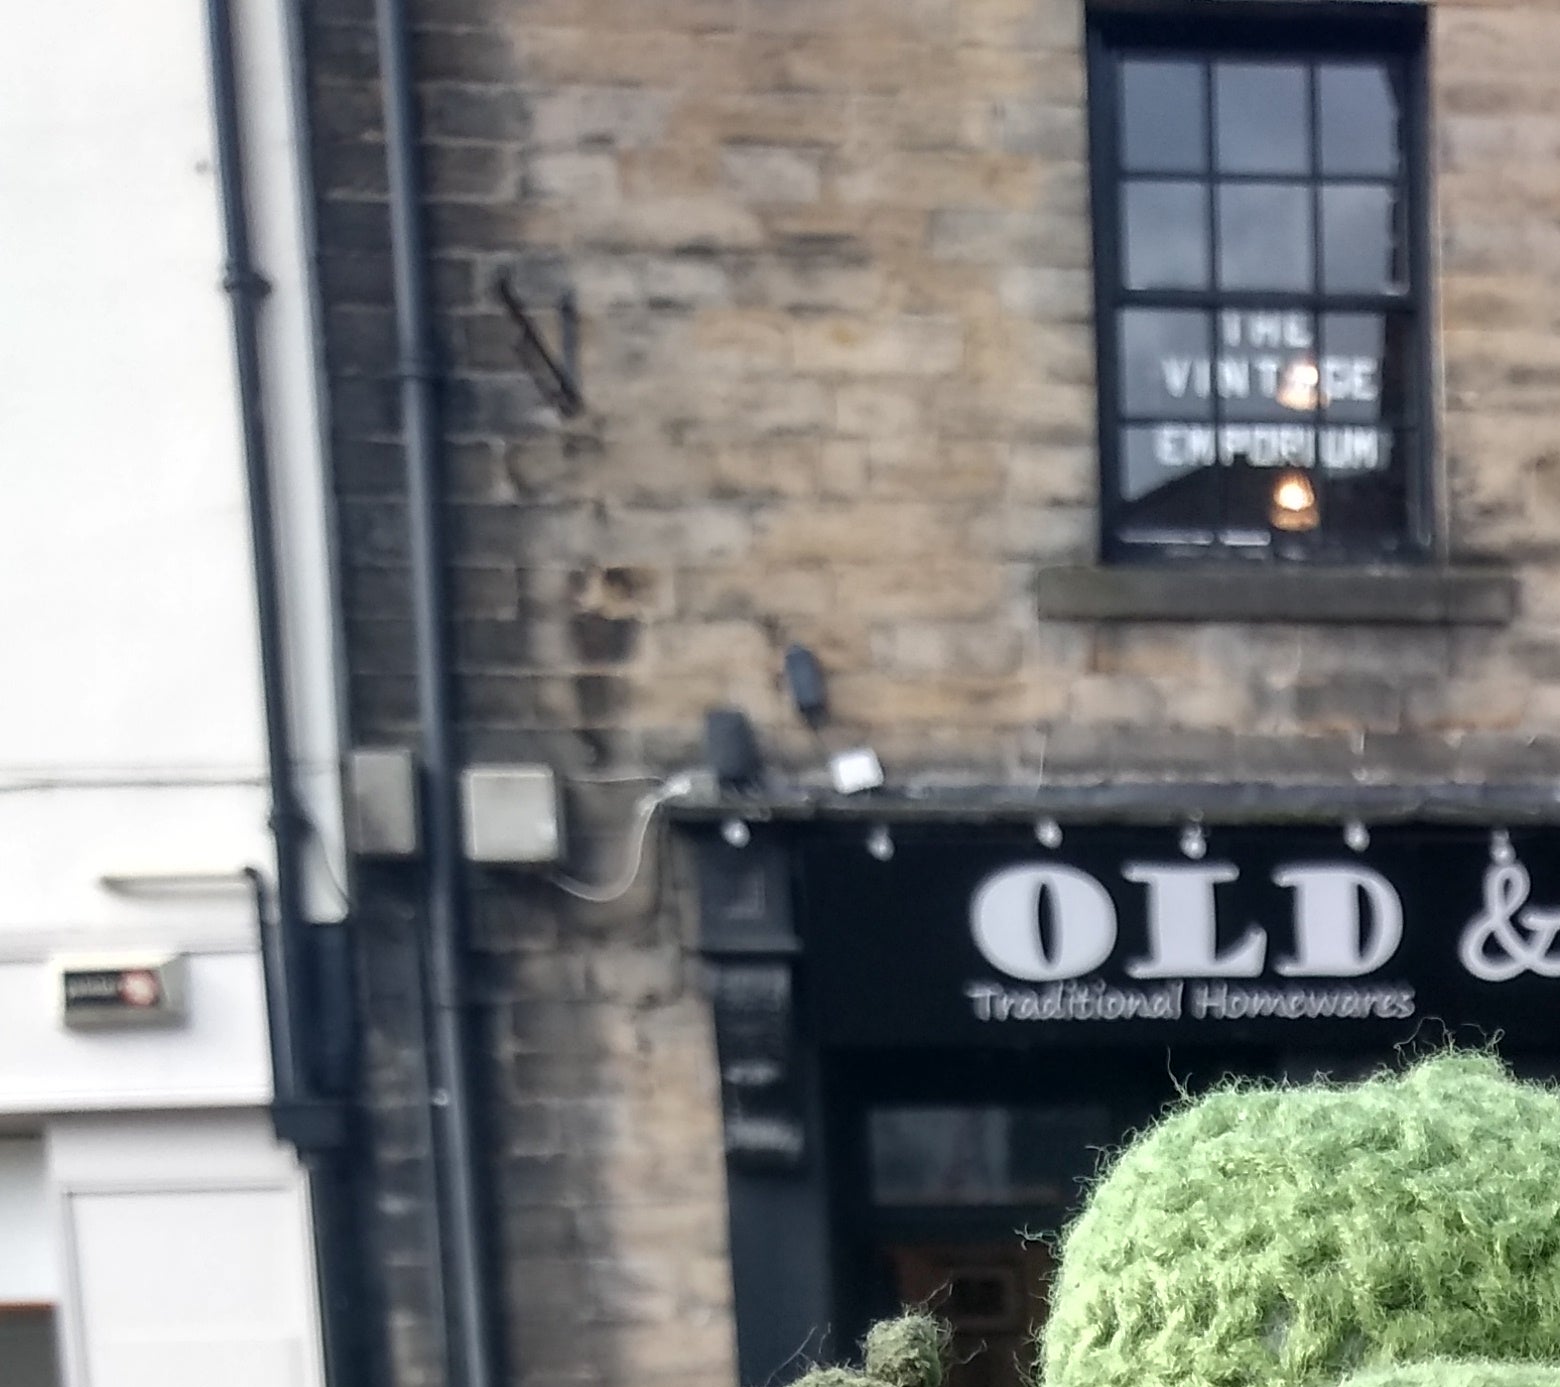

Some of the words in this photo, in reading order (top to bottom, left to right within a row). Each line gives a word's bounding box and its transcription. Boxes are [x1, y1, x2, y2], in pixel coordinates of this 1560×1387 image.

[1221, 308, 1313, 347] THE
[1161, 356, 1379, 401] VINTGE
[969, 862, 1404, 981] OLD
[964, 979, 1184, 1020] Traditional
[1188, 979, 1415, 1019] Homewares
